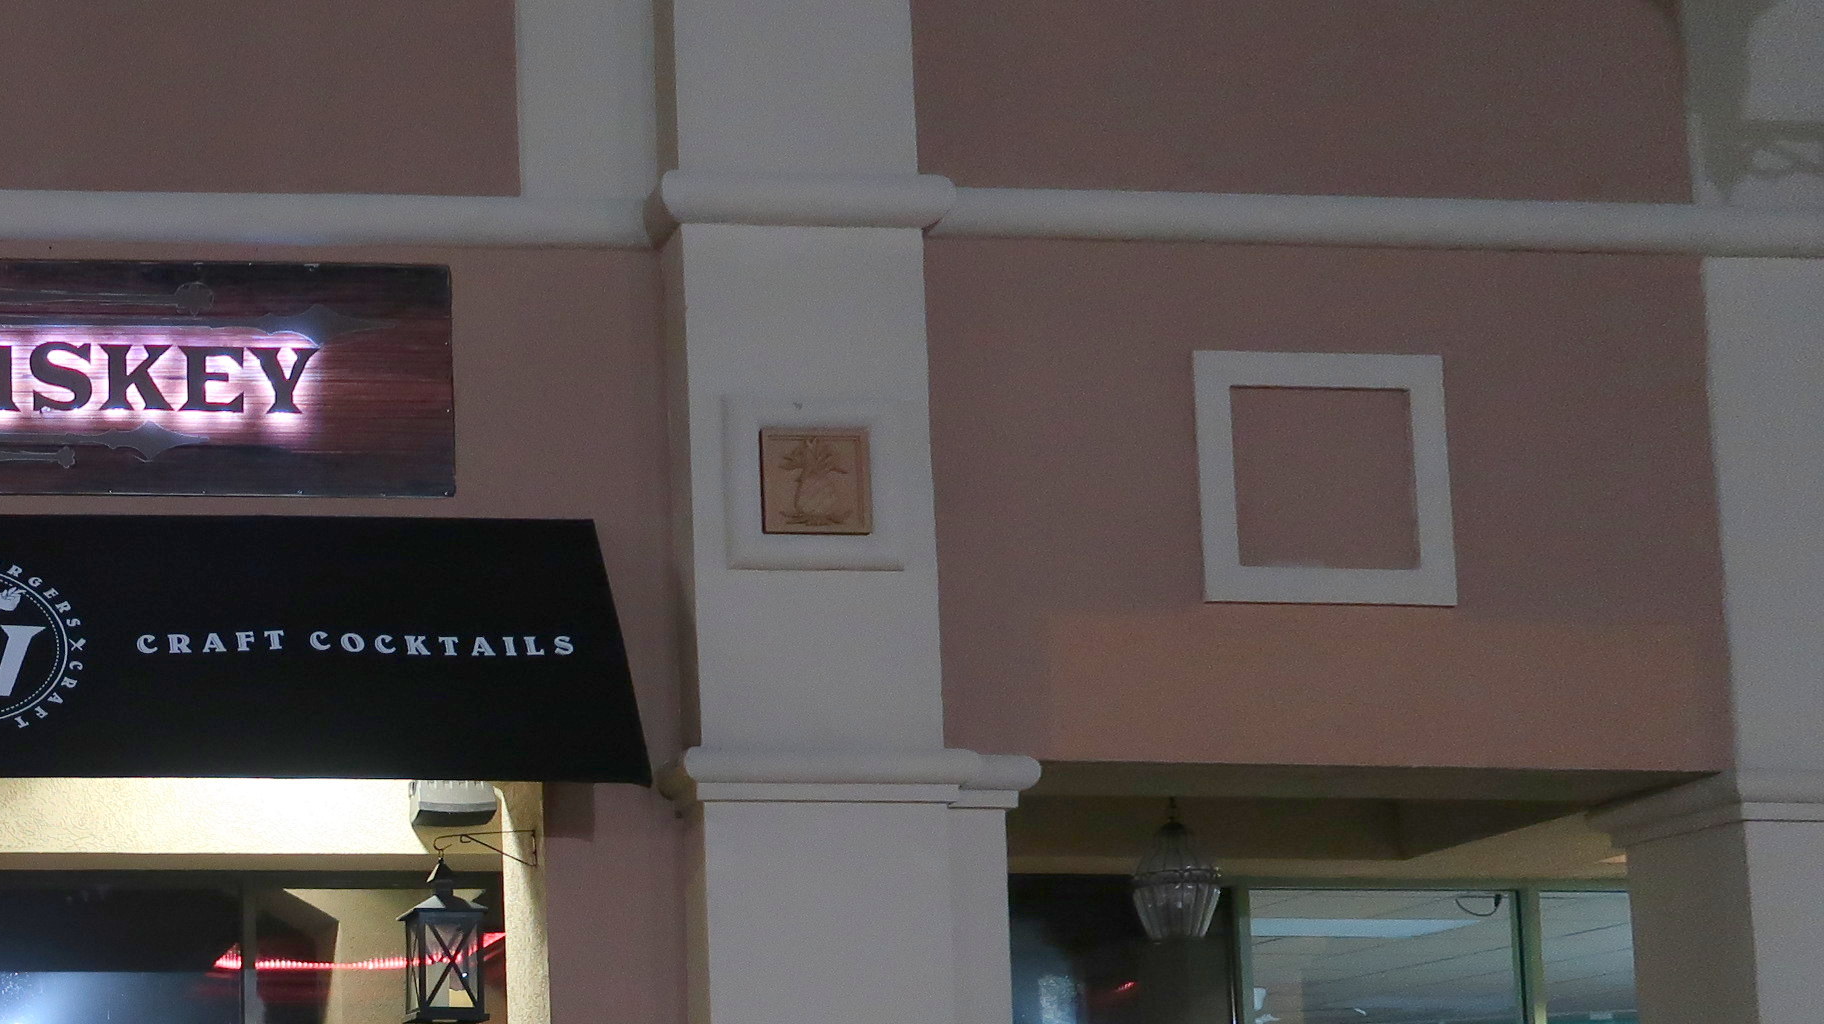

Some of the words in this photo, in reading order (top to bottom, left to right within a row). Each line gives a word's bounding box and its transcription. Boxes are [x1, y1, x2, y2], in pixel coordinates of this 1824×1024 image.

[136, 630, 285, 653] CRAFT
[309, 630, 575, 656] COCKTAILS
[13, 660, 84, 729] CRAFT
